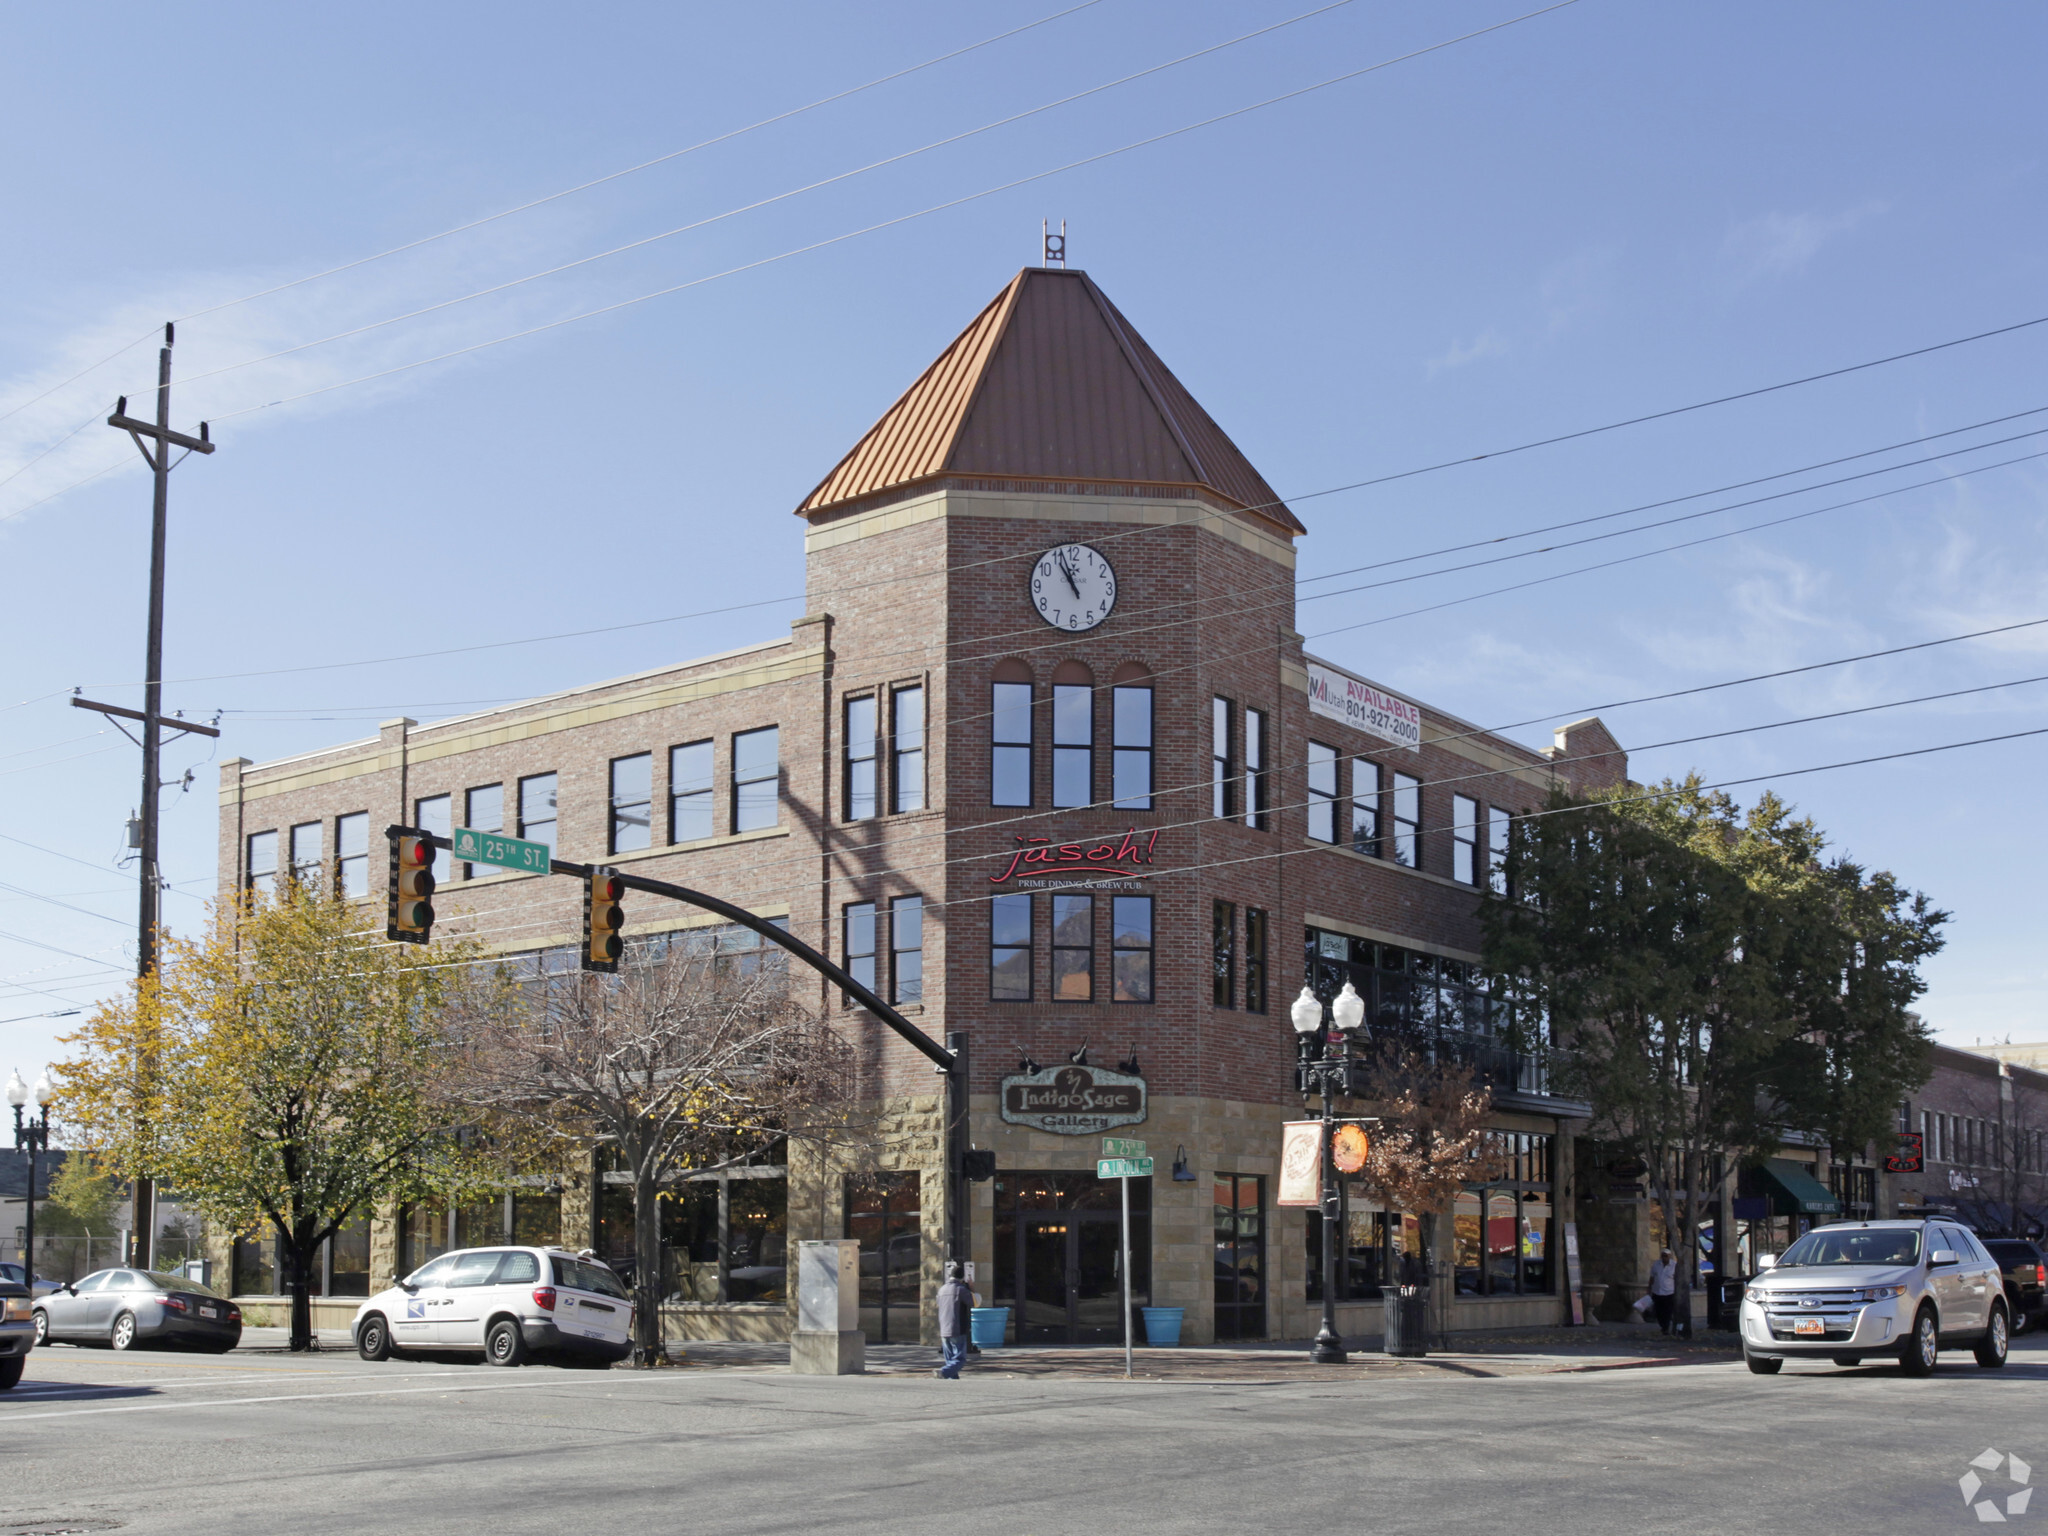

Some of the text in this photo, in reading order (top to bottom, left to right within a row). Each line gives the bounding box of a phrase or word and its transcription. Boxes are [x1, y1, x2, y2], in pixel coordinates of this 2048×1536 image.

[1052, 549, 1063, 566] 11
[1067, 546, 1080, 562] 12
[1087, 551, 1093, 567] 1
[1038, 562, 1052, 577] 10
[1099, 563, 1107, 578] 2
[1033, 579, 1042, 594] 9
[1105, 581, 1114, 596] 3
[1039, 597, 1048, 612] 8
[1099, 598, 1107, 613] 4
[1053, 609, 1061, 625] 7
[1069, 614, 1078, 629] 6
[1086, 610, 1094, 625] 5
[1309, 676, 1328, 703] NAI
[1328, 691, 1346, 711] Utah
[1346, 680, 1418, 725] AVAILABLE
[1346, 699, 1418, 742] 801-927-2000
[486, 841, 516, 860] 25TH
[524, 848, 544, 868] ST.
[1018, 878, 1142, 890] PRIME DINING & BREW PUB
[1041, 1115, 1108, 1128] Gallery
[1112, 1159, 1140, 1176] LINCOLN
